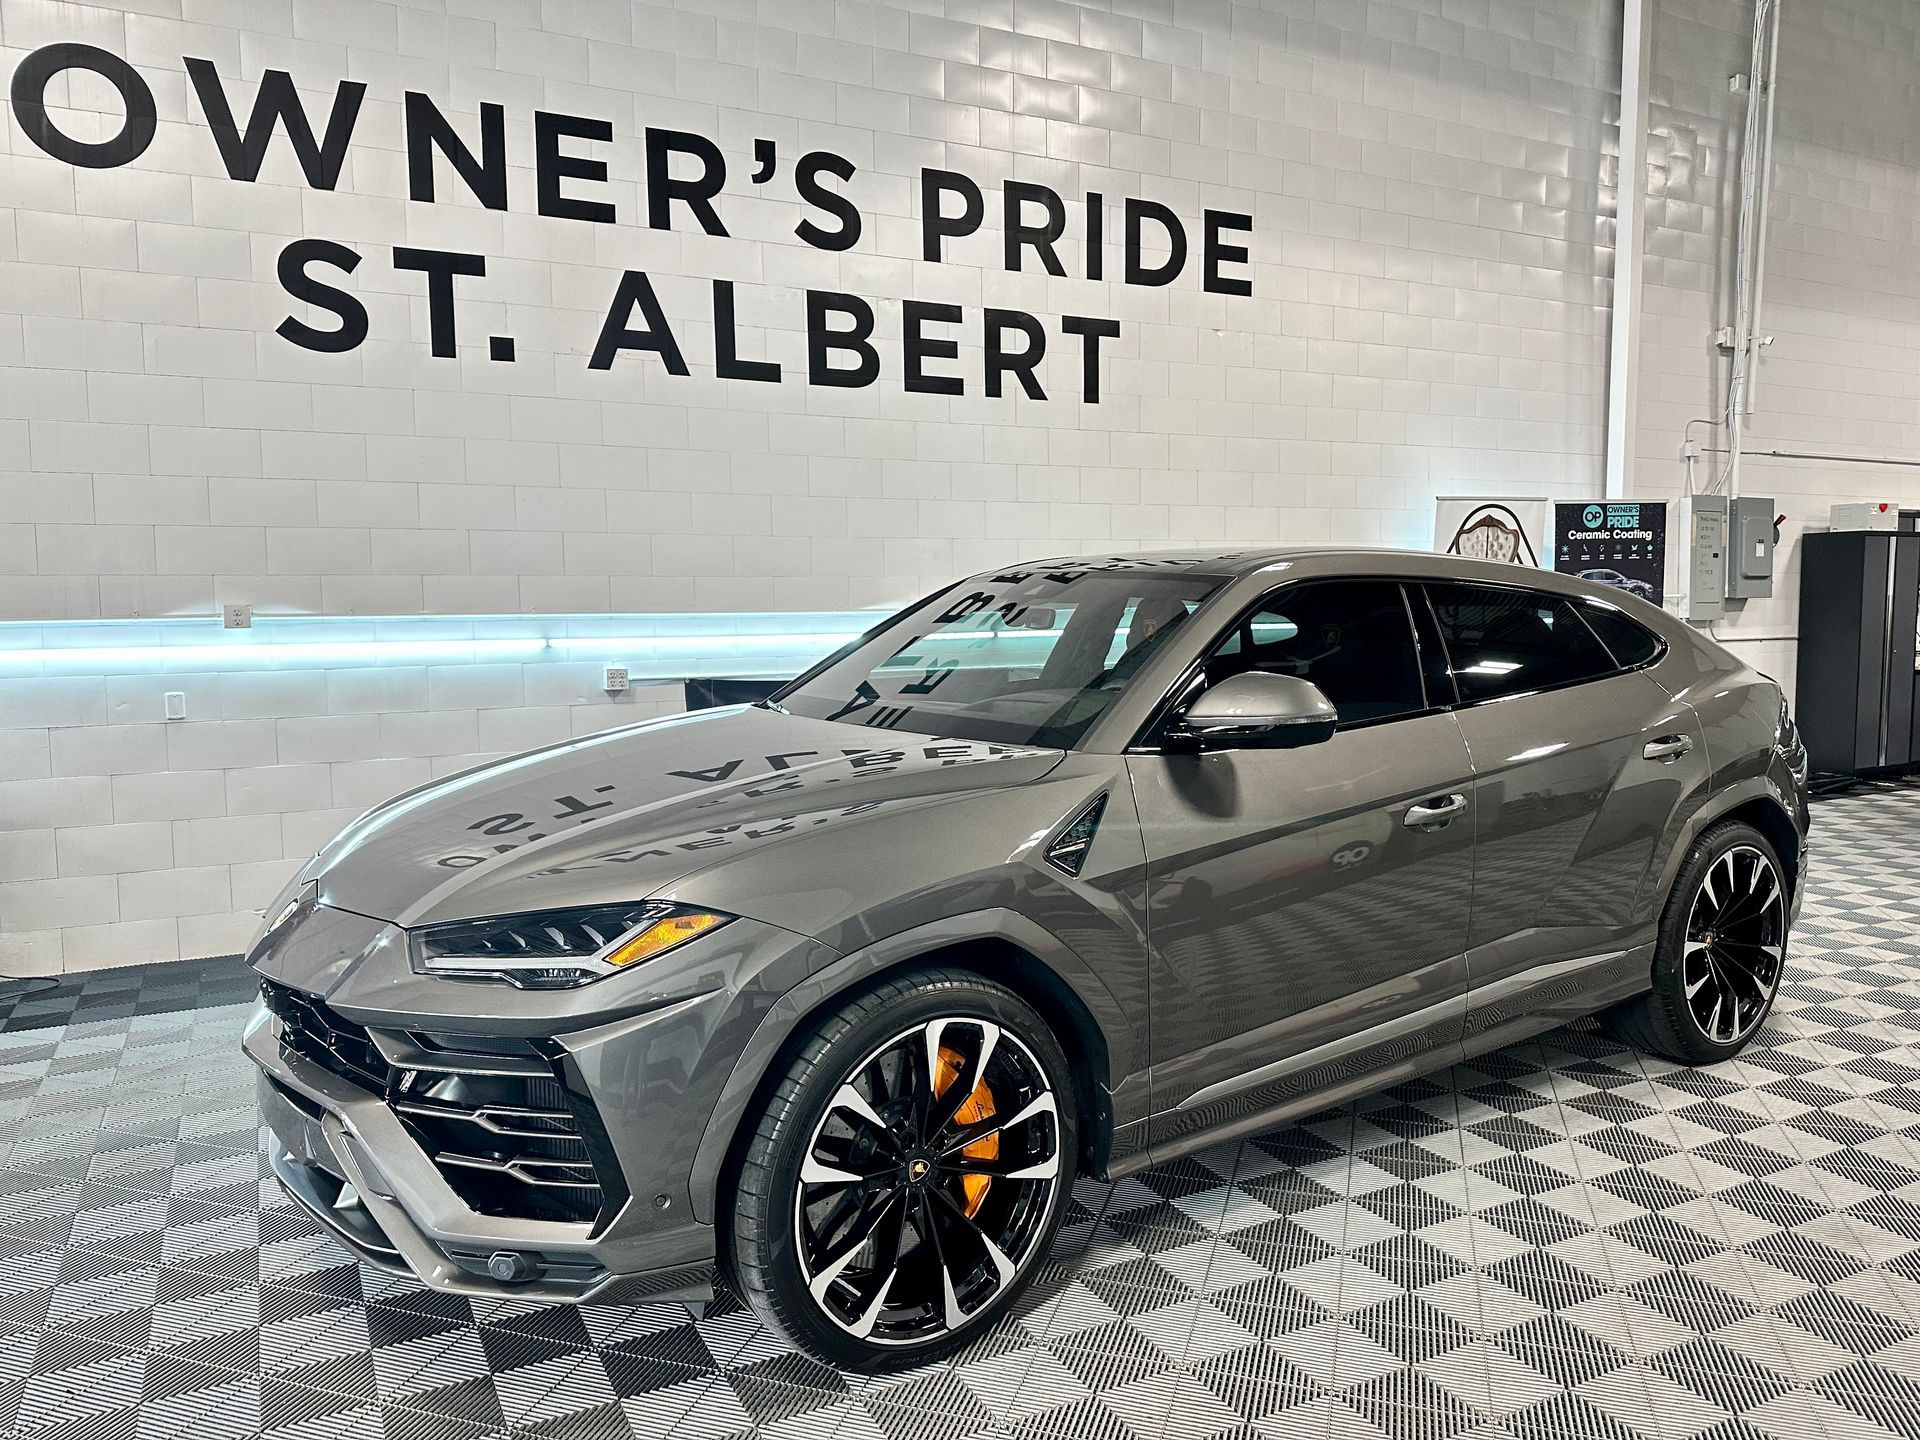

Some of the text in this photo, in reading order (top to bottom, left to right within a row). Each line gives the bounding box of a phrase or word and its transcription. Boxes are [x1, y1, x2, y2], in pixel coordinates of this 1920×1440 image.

[11, 42, 1253, 298] OWNER'S PRIDE
[275, 238, 1121, 405] ST. ALBERT
[1607, 506, 1640, 514] OWNER'S
[1584, 511, 1602, 523] OP
[1606, 516, 1640, 528] PRIDE
[1567, 529, 1653, 541] Ceramic Coating
